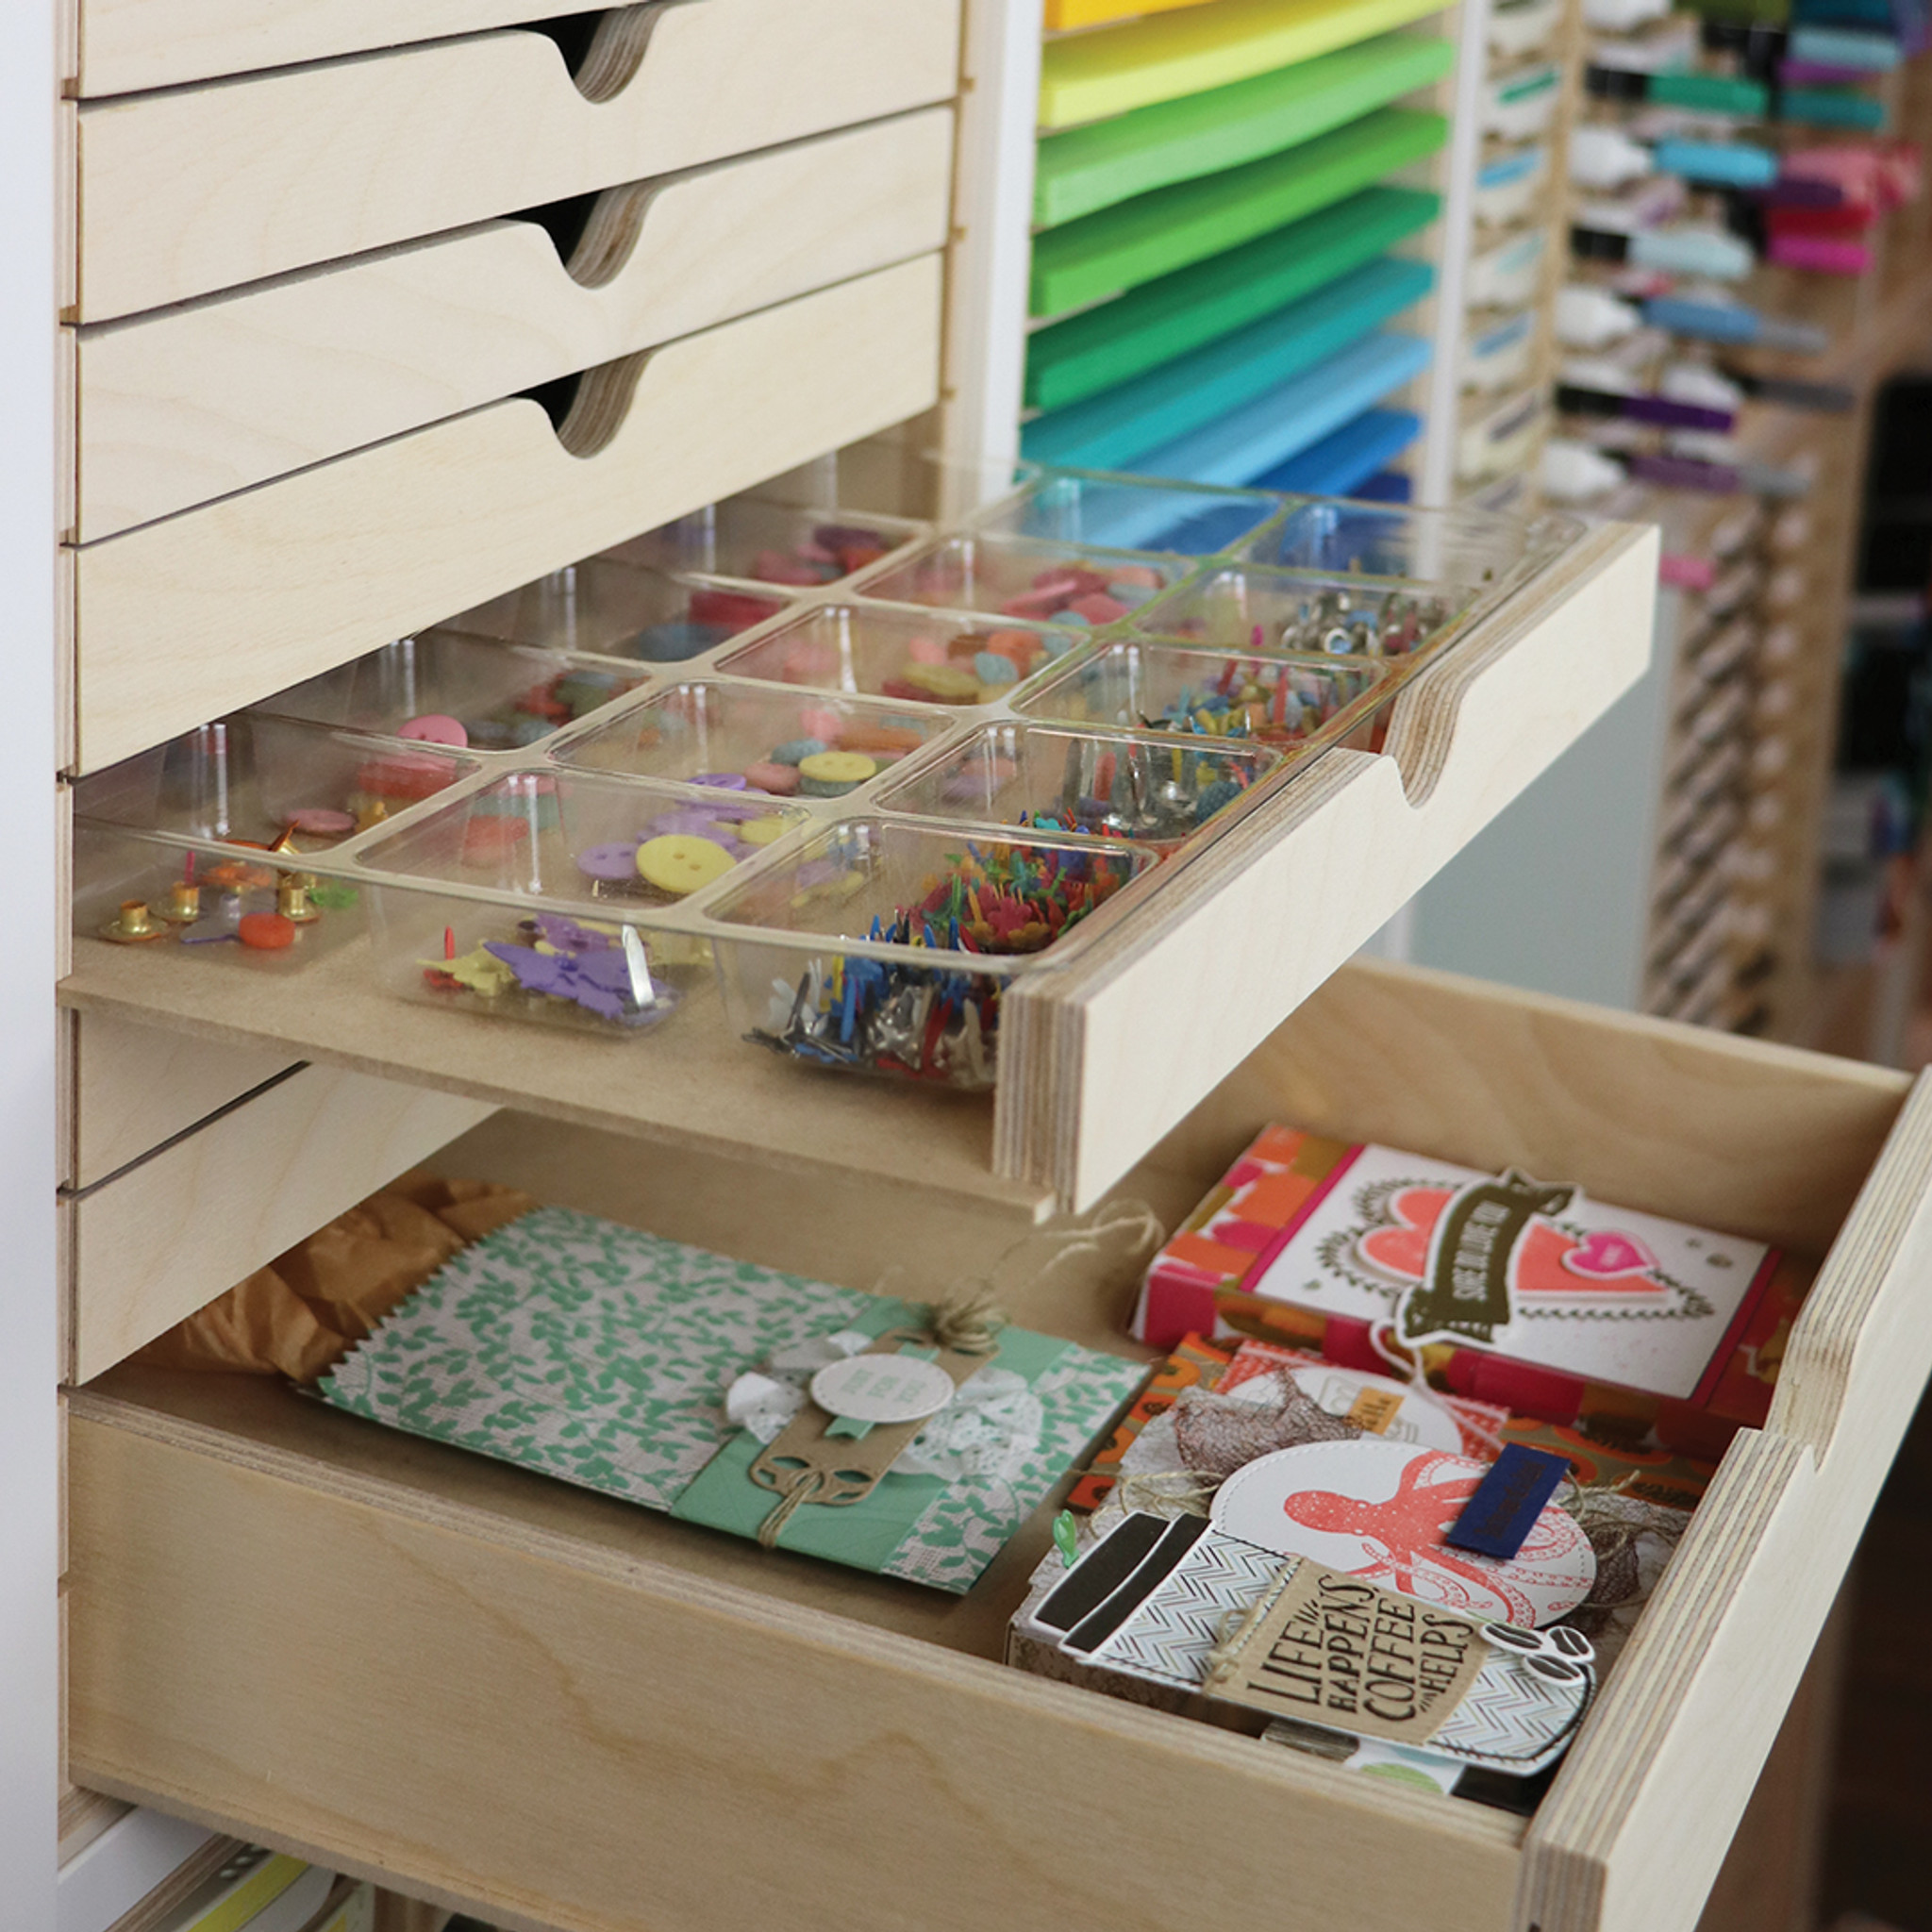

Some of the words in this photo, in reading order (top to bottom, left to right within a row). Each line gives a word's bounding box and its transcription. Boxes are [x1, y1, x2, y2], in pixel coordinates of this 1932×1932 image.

[1245, 1621, 1324, 1706] LIFE
[1362, 1597, 1416, 1722] COFFEE
[1418, 1613, 1474, 1694] HELPS
